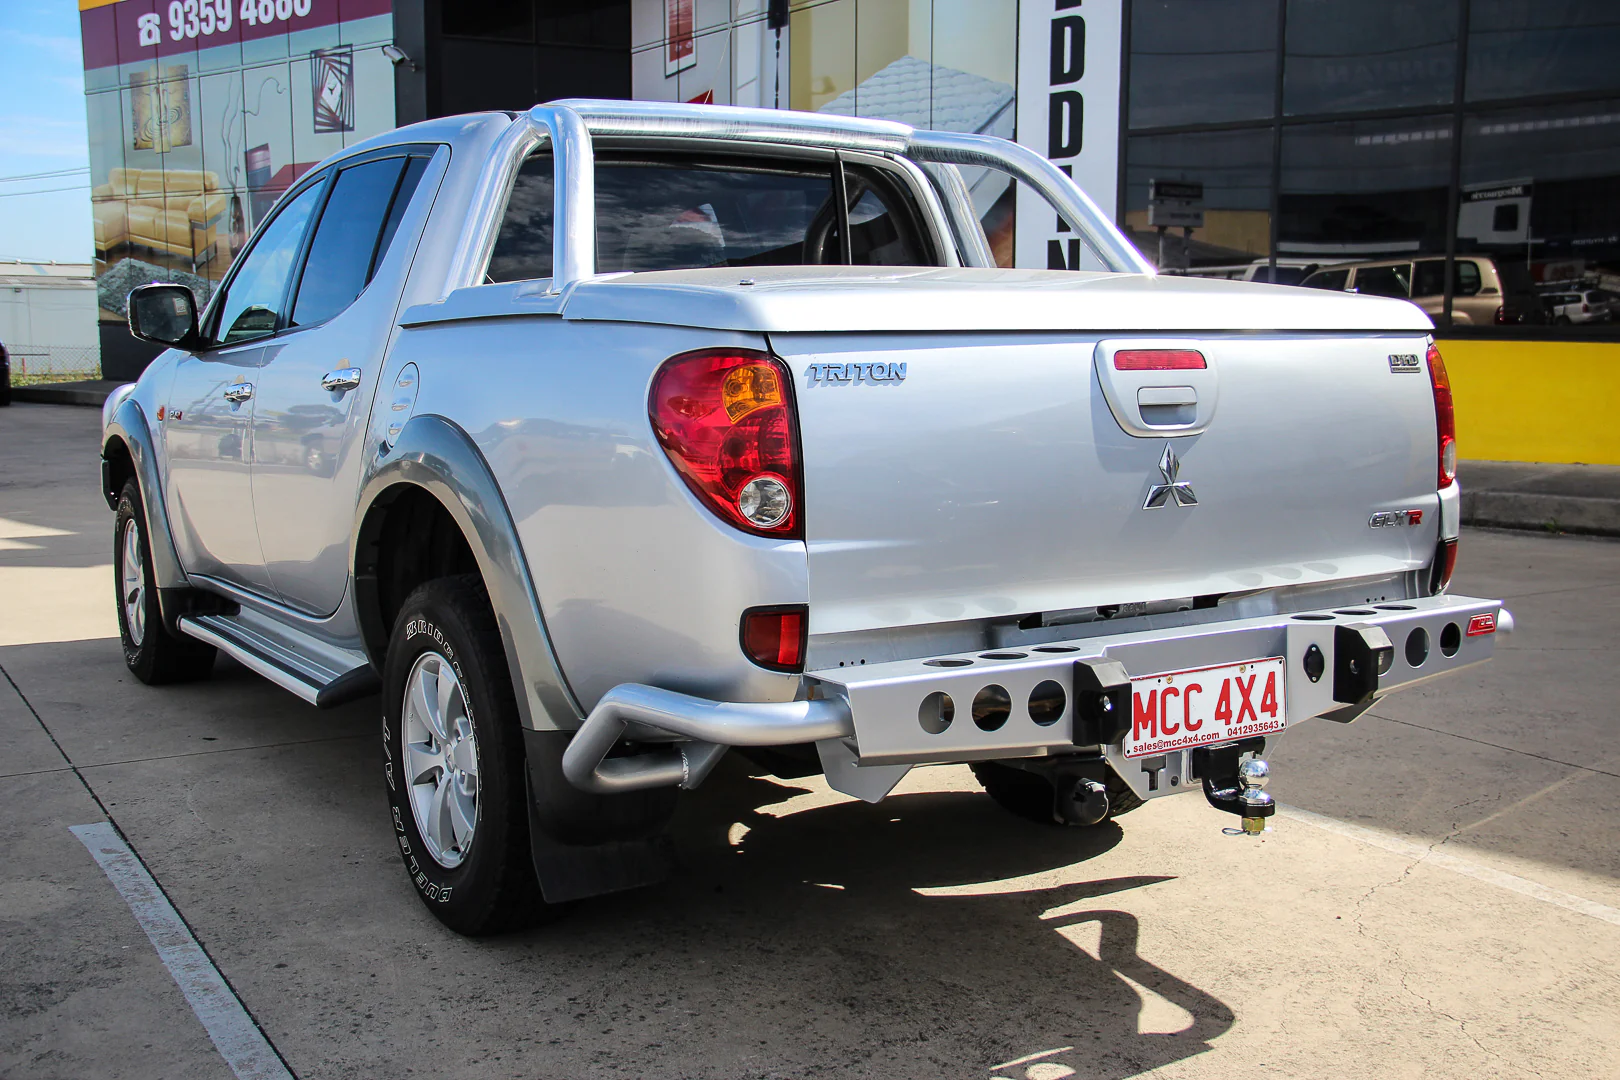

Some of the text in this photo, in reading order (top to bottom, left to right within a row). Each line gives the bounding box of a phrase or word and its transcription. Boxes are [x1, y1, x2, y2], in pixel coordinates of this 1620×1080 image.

[168, 0, 233, 41] 9359
[809, 362, 907, 382] TRITON
[1132, 671, 1278, 741] MCC 4X4
[1132, 720, 1279, 753] sales@mcc4x4.com 0412935643
[392, 806, 453, 903] DUELER
